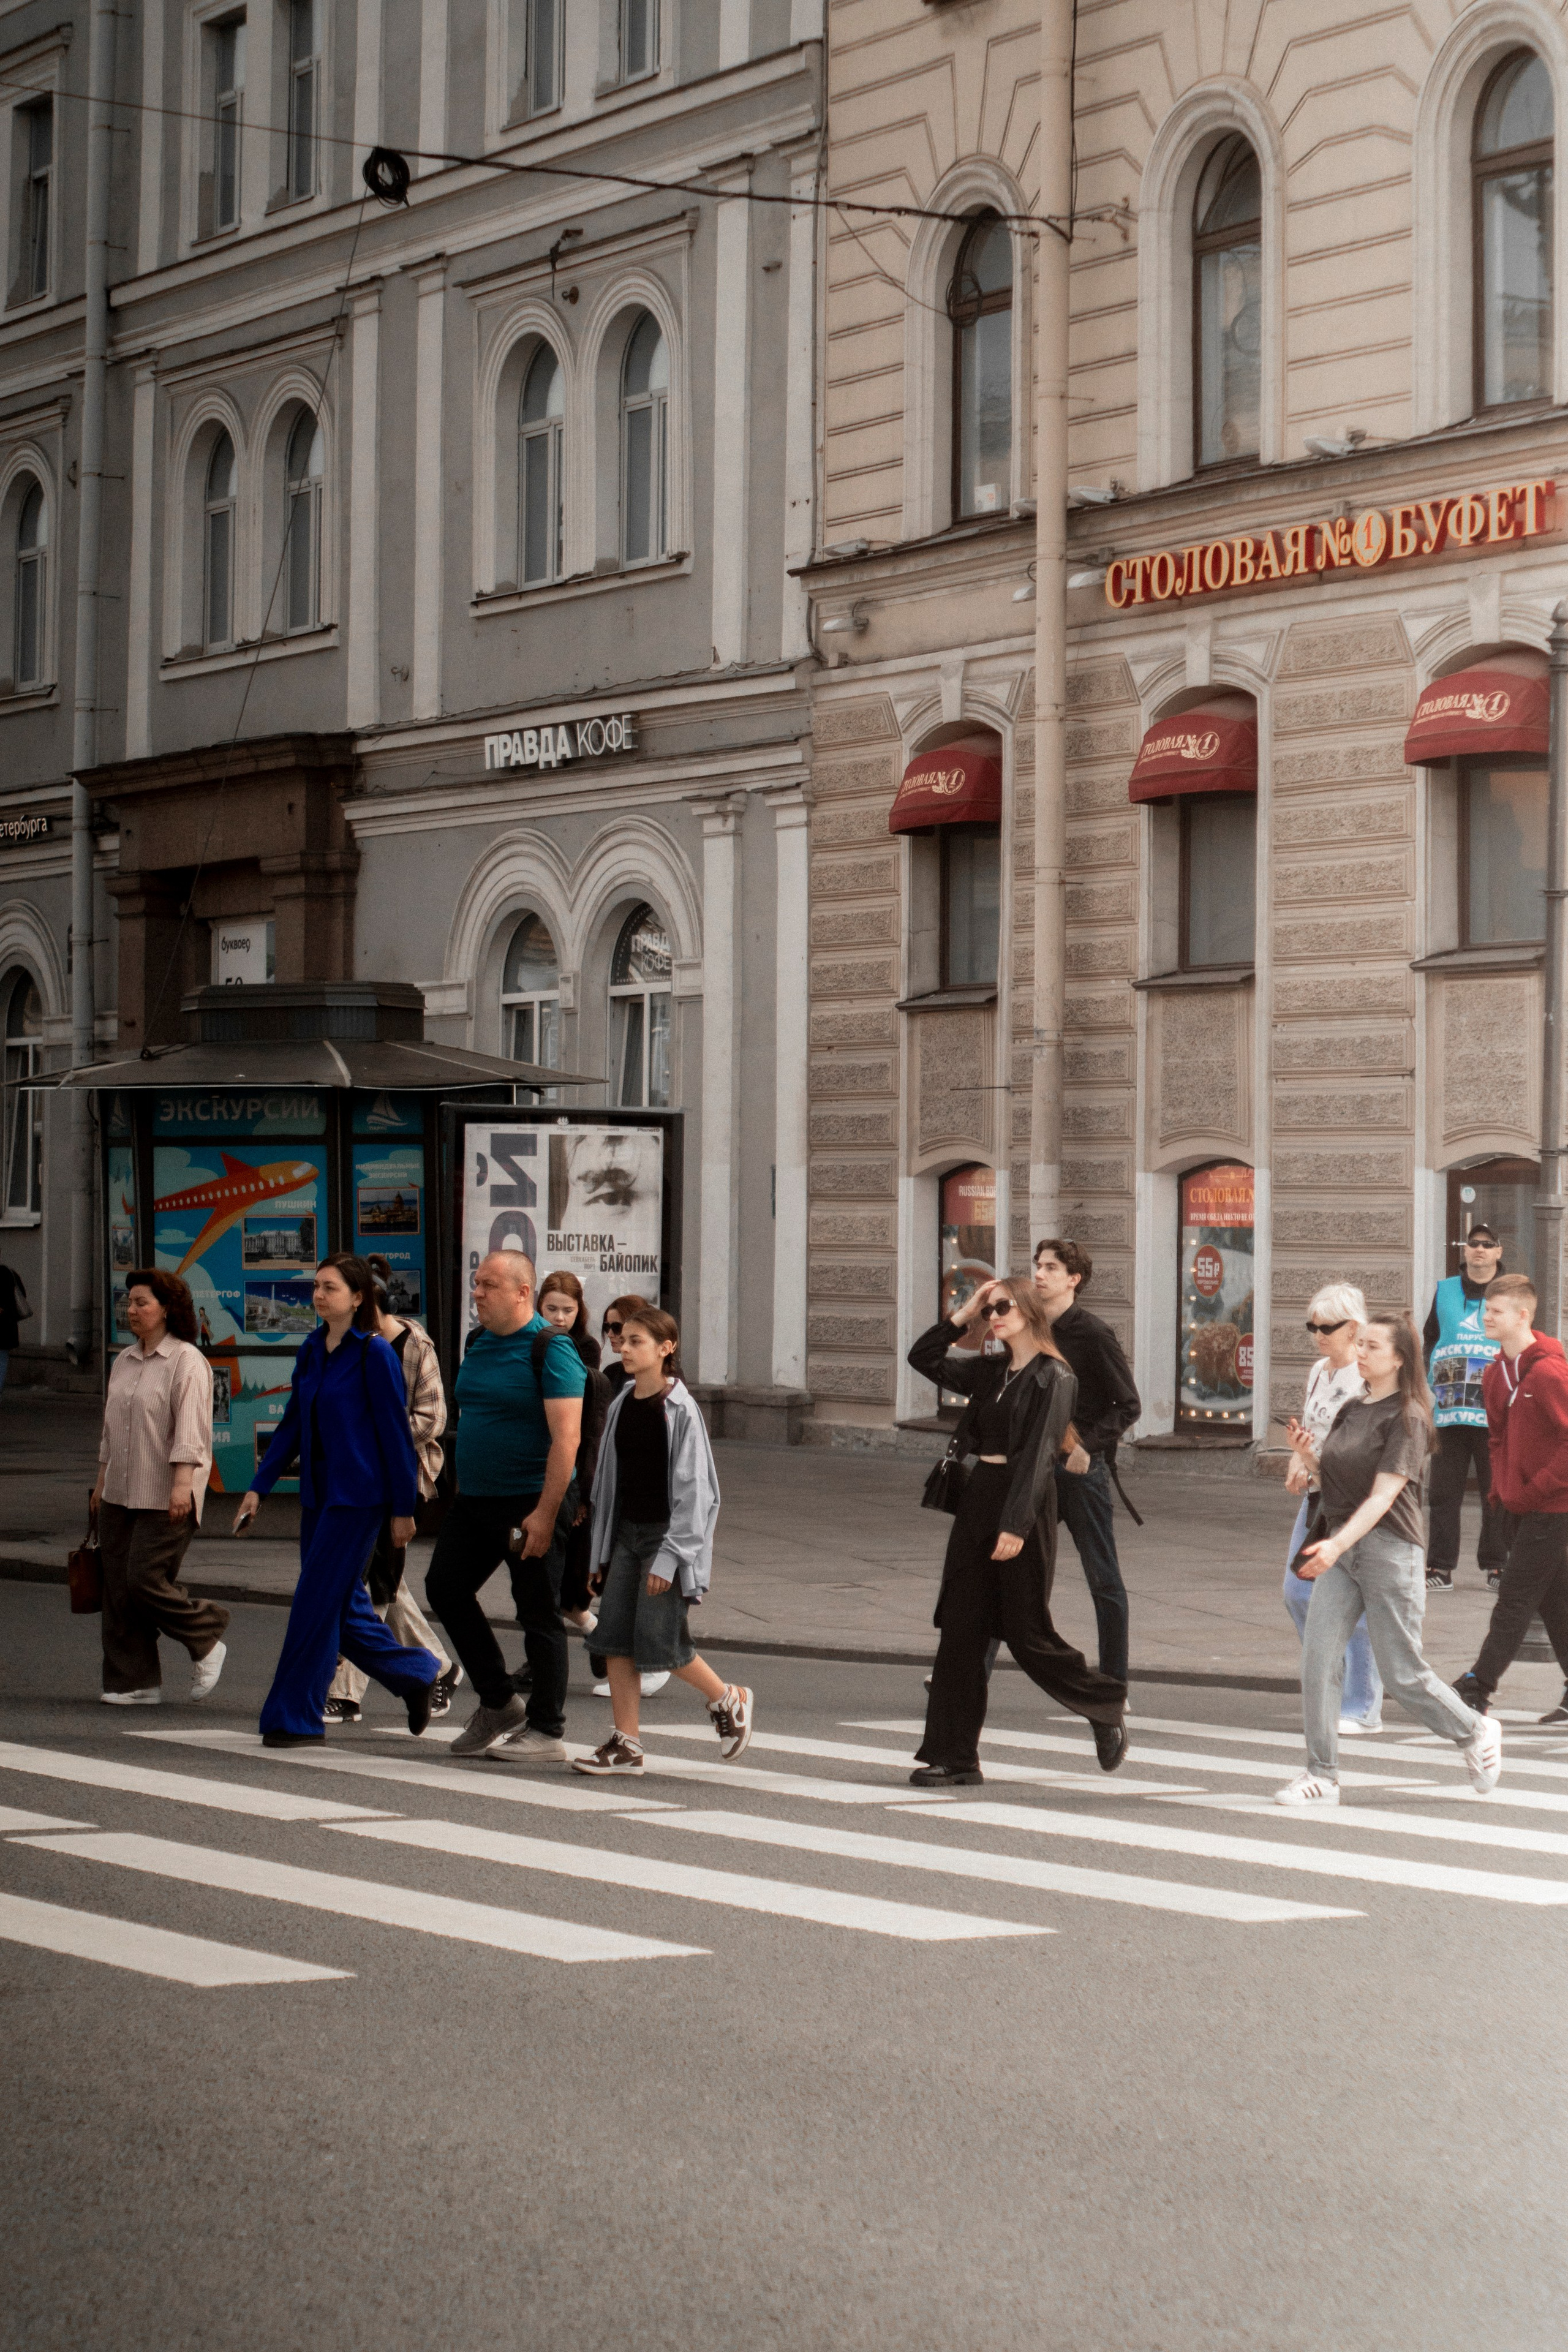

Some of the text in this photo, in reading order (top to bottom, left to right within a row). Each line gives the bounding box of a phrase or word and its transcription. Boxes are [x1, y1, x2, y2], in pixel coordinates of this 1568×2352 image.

[1104, 525, 1311, 609] СТОЛОВАЯ
[1389, 480, 1547, 559] БУФЕТ
[484, 714, 632, 770] ПРАВДА КОФЕ
[641, 953, 671, 973] КОФЕ
[159, 1096, 319, 1121] ЭКСКУРСИИ
[959, 1185, 985, 1197] RUSSIAN
[1189, 1187, 1246, 1204] СТОЛОВАЯ
[275, 1200, 317, 1208] ПУШКИН
[546, 1233, 615, 1253] ВЫСТАВКА
[600, 1253, 658, 1273] БАЙОПИК
[1457, 1333, 1484, 1341] ПАРУС
